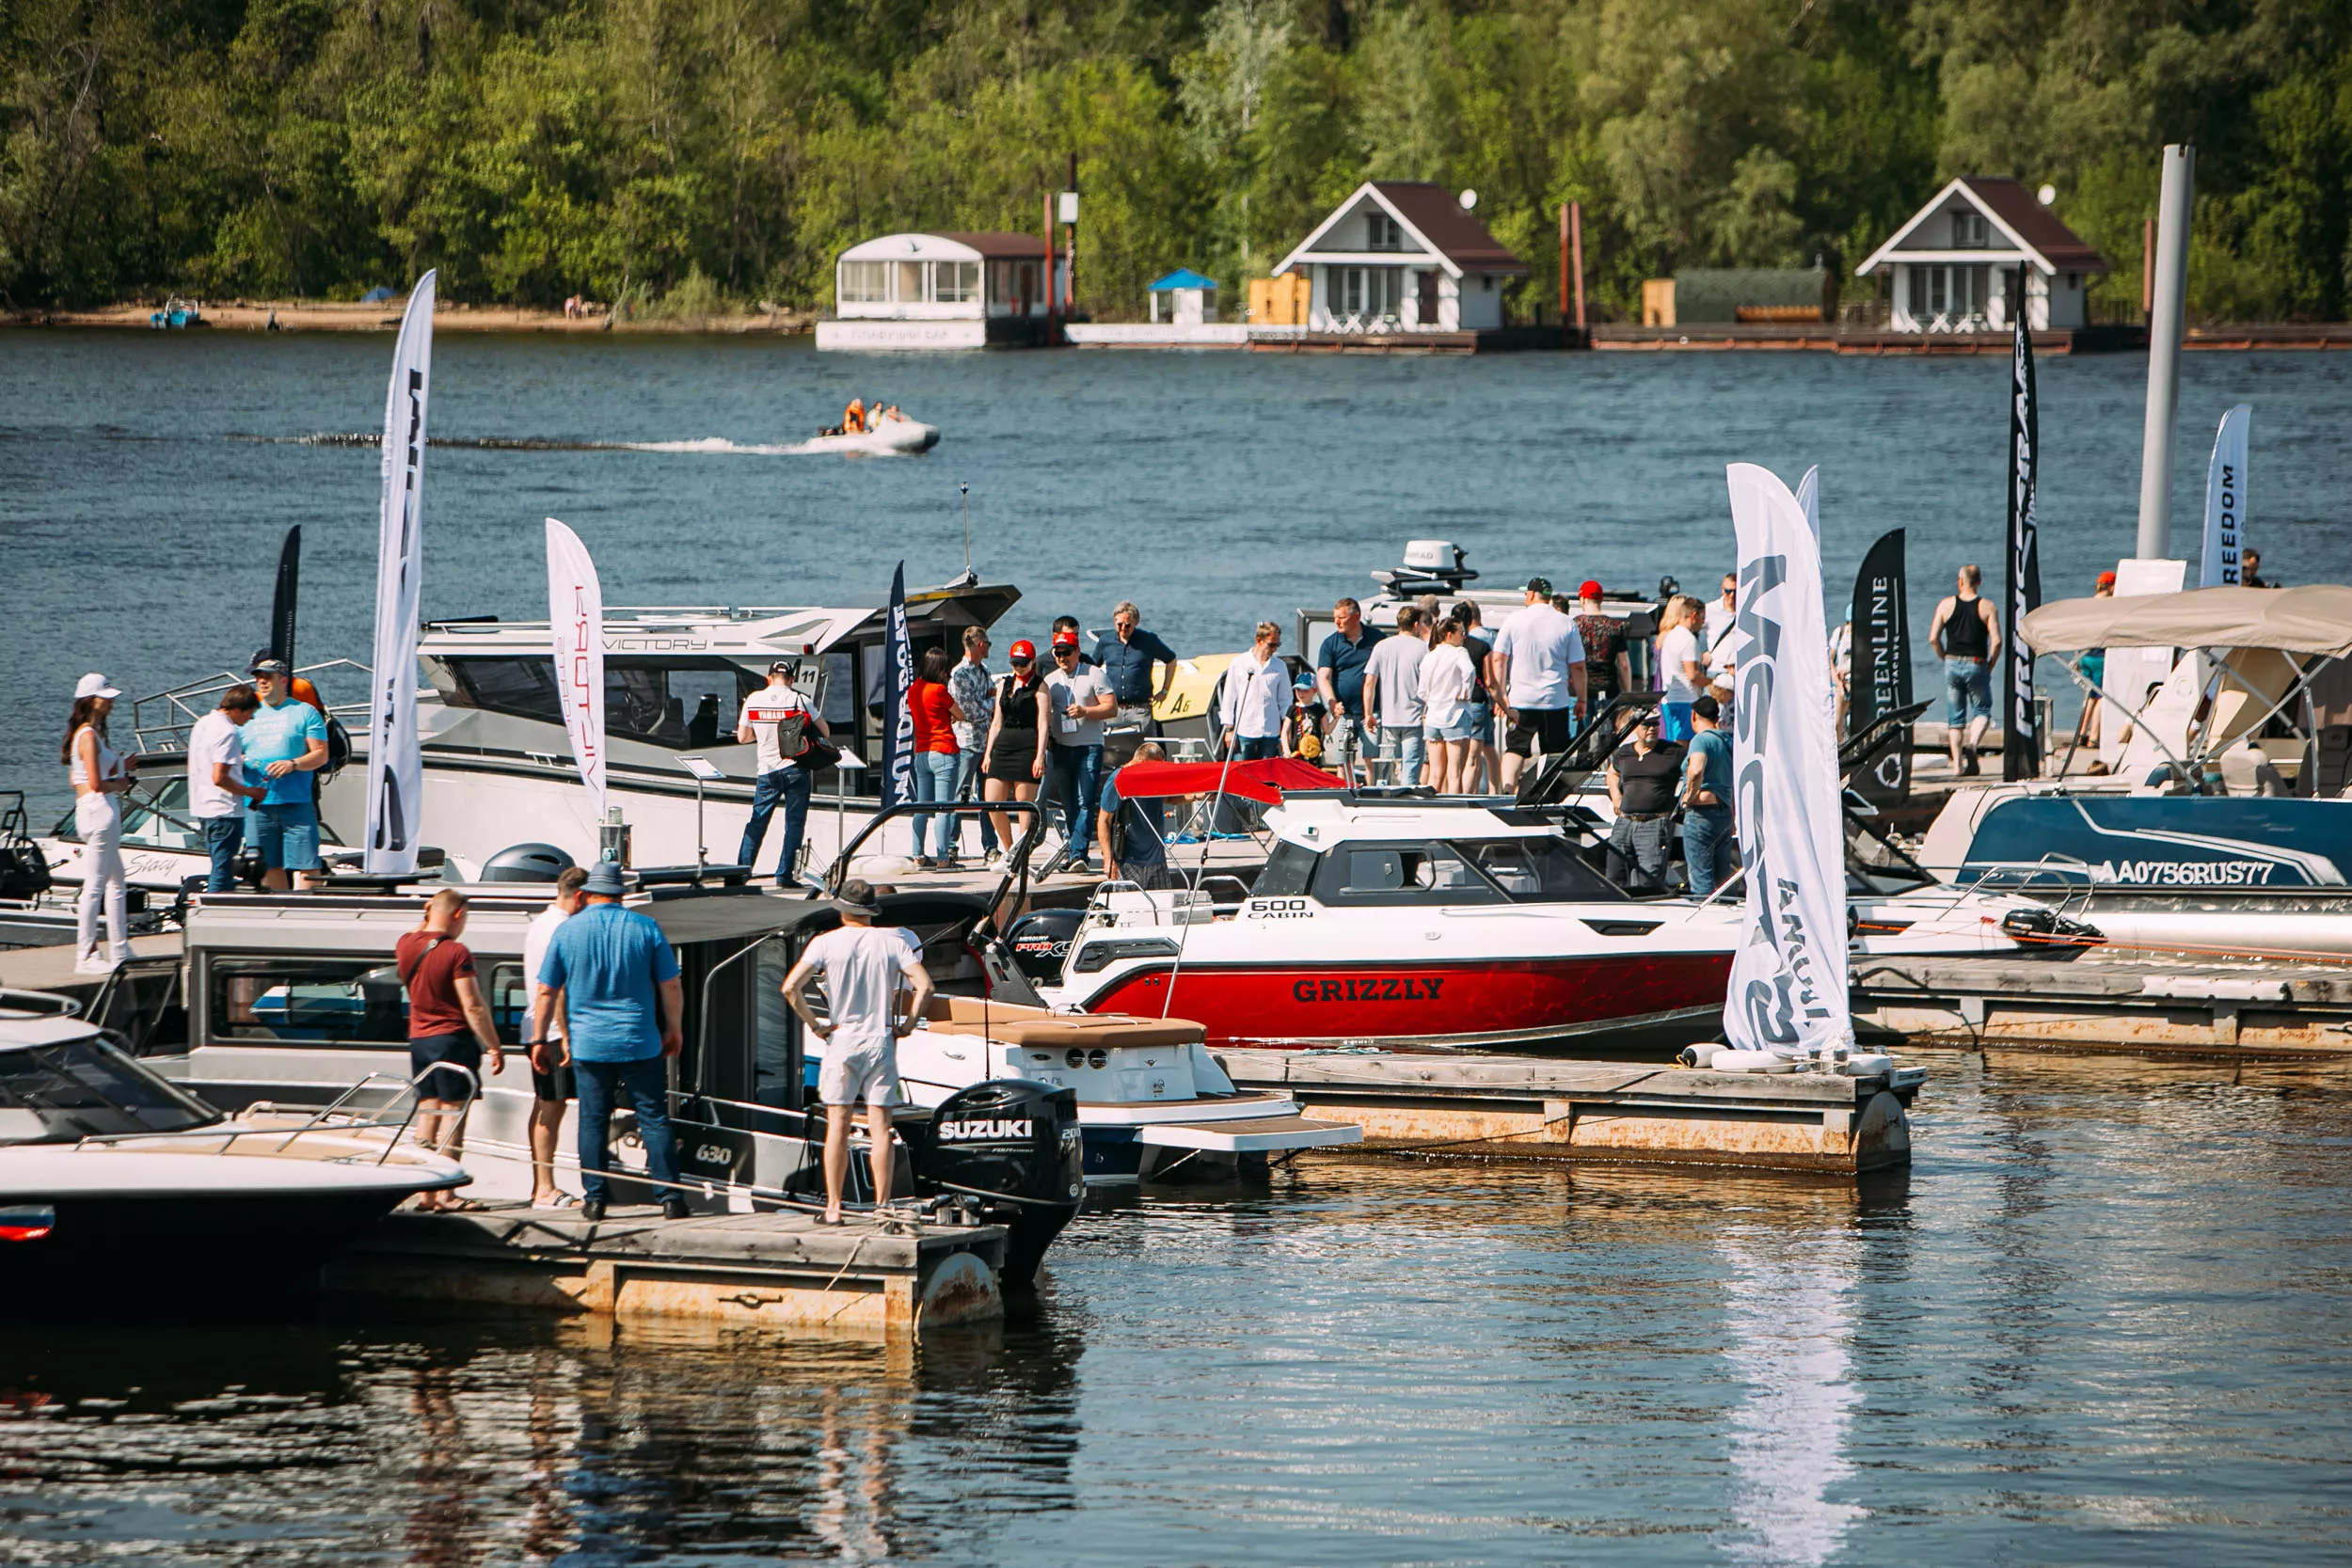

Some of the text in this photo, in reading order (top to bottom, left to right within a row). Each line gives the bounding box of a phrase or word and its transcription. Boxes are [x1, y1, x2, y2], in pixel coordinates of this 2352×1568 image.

[2221, 465, 2239, 585] REEDOM
[602, 639, 707, 650] VICTORY
[1870, 577, 1892, 719] REENLINE
[1891, 635, 1900, 686] YACHTS
[757, 710, 787, 721] YAMAHA
[2099, 860, 2275, 885] AA0756RUS77
[1250, 899, 1306, 911] 600
[1248, 911, 1313, 920] CABIN
[1016, 942, 1053, 952] PRO
[1293, 978, 1444, 1003] GRIZZLY
[939, 1119, 1033, 1140] SUZUKI
[696, 1144, 732, 1164] 630
